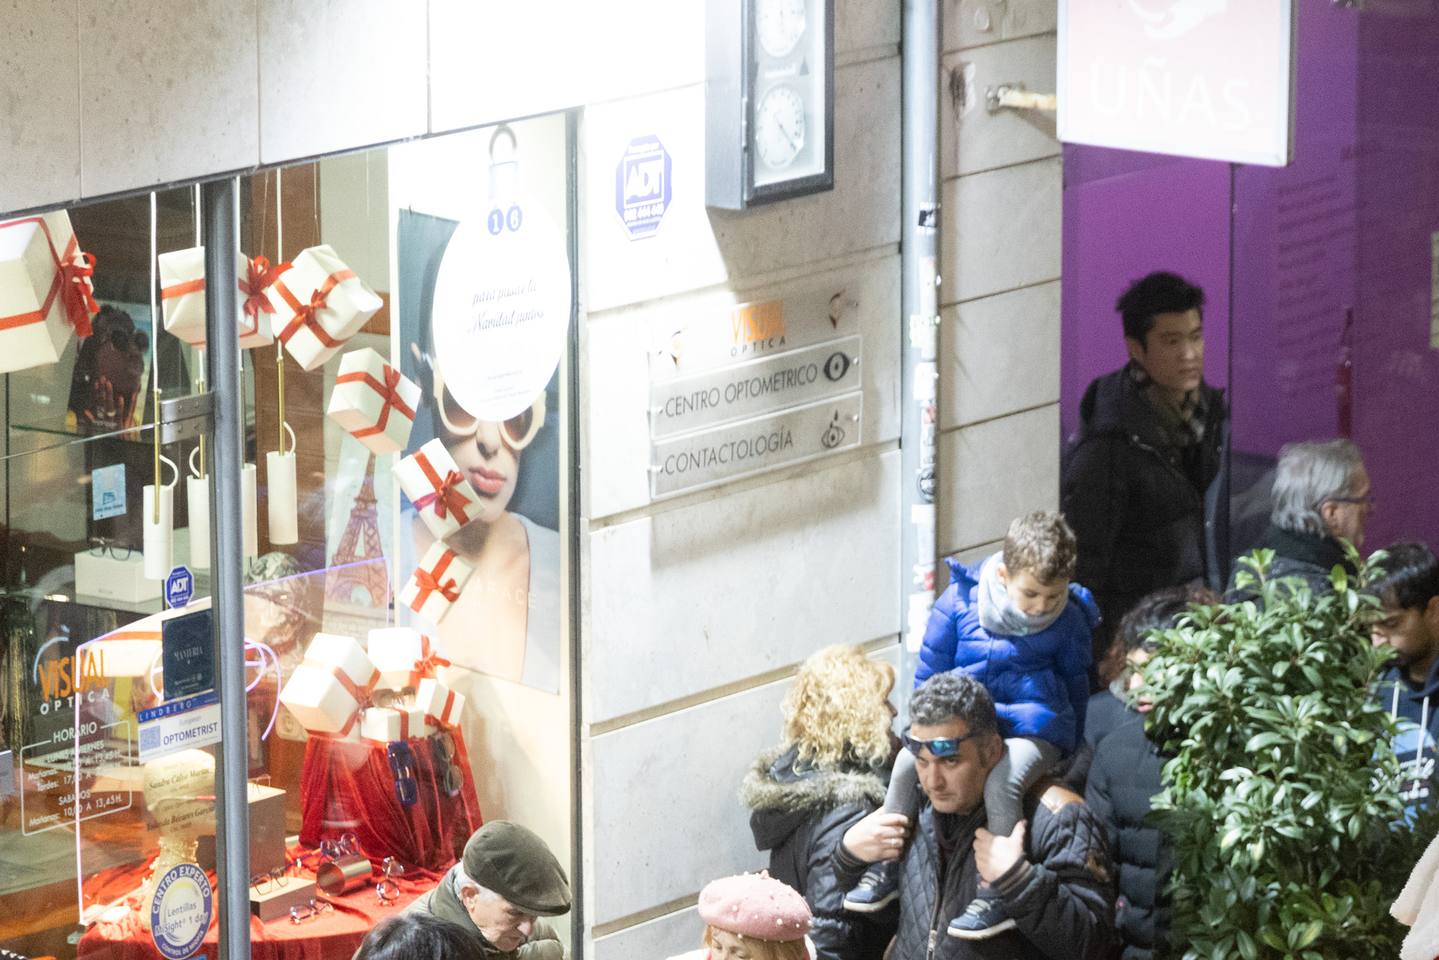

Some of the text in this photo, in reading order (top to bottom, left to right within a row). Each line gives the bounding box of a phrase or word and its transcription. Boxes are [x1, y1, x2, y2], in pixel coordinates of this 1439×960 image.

[1089, 56, 1252, 133] UÑAS
[626, 160, 661, 200] ADT
[731, 336, 787, 358] OPTICA
[665, 362, 819, 418] CENTRO OPTOMETRICO
[664, 424, 794, 476] CONTACTOLOGÍA
[171, 577, 189, 595] ADT
[40, 688, 109, 715] OPTICA
[139, 701, 192, 722] LINDBERG
[163, 722, 219, 746] OPTOMETRIST
[58, 789, 91, 806] SABAOS
[63, 804, 83, 817] 10,0
[153, 865, 210, 914] CENTRO EXPERTO
[167, 903, 198, 918] Lentillas
